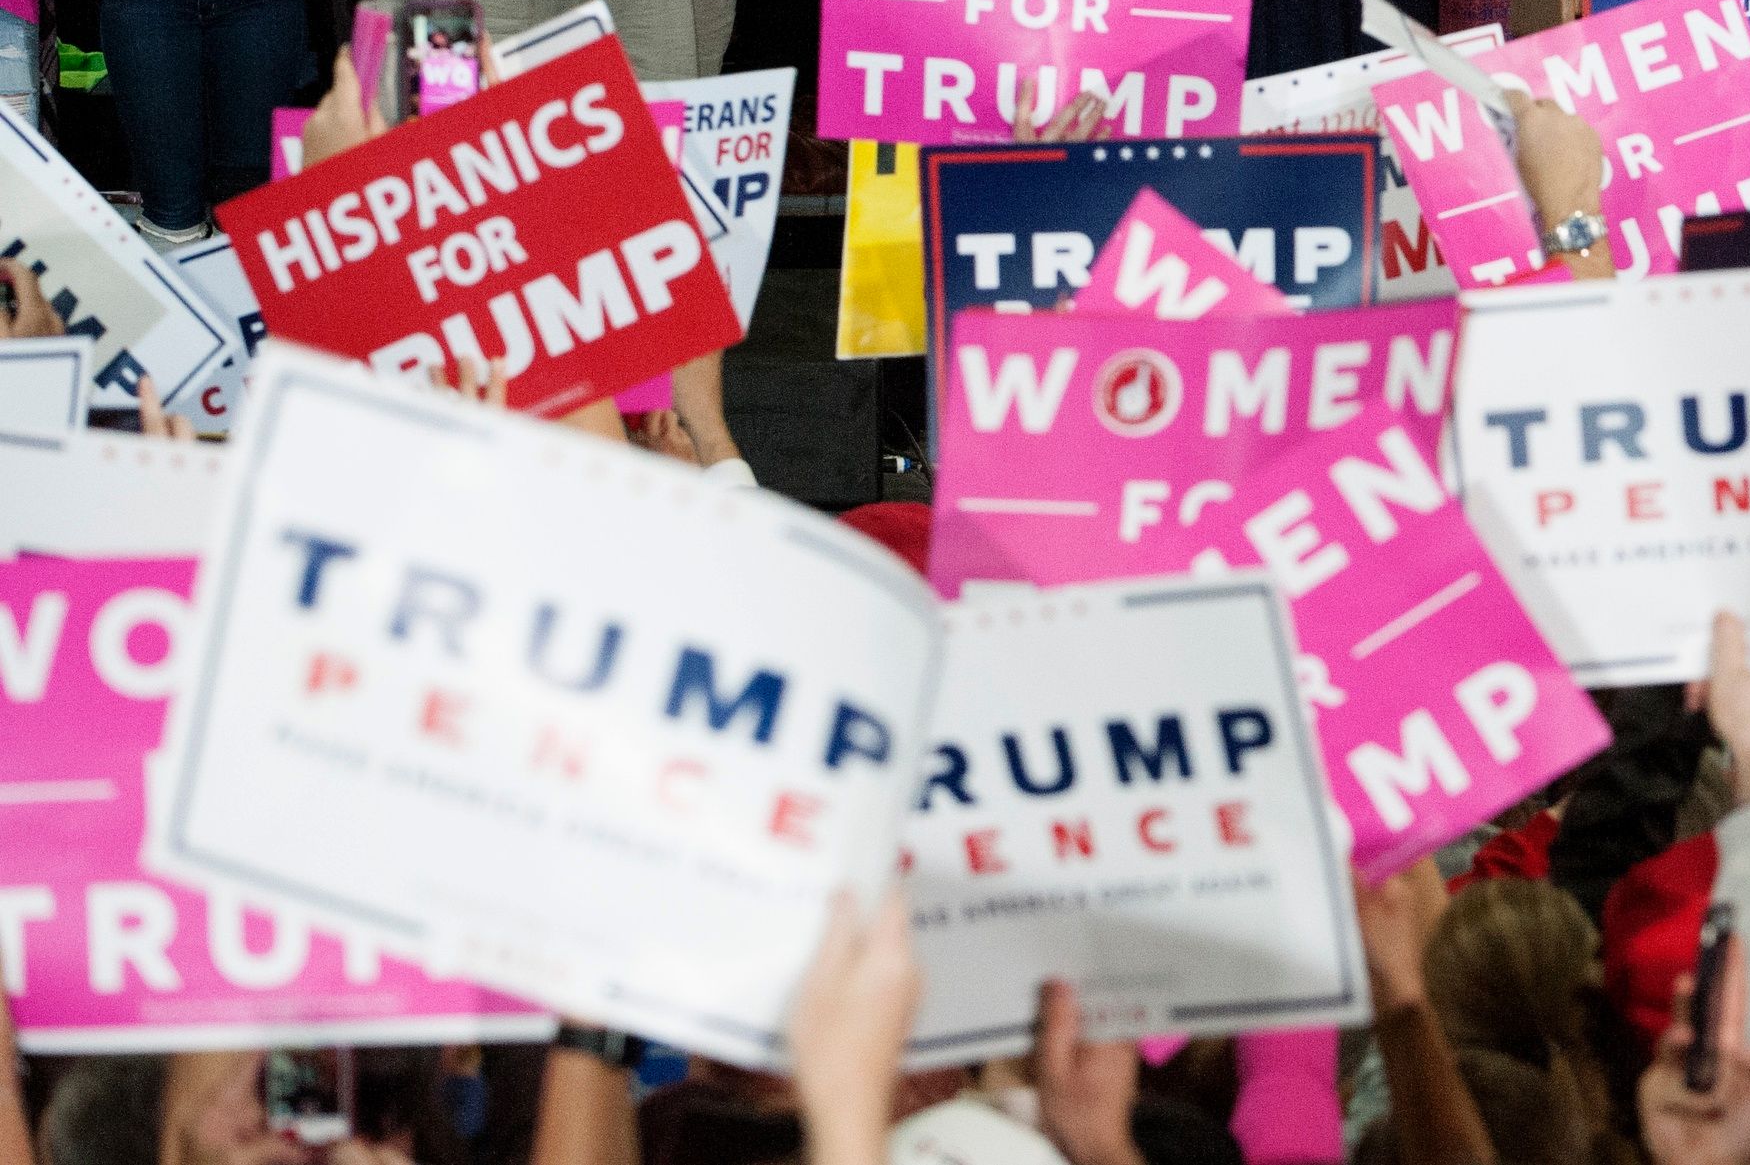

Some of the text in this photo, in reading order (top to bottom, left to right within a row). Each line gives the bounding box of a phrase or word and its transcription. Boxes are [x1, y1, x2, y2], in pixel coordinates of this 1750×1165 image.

[846, 51, 1216, 136] TRUMP
[256, 82, 625, 293] HISPANICS
[716, 131, 773, 167] FOR
[408, 216, 528, 303] FOR
[279, 526, 892, 774] TRUMP
[299, 650, 824, 848] PENCE
[916, 704, 1277, 813] RUMP
